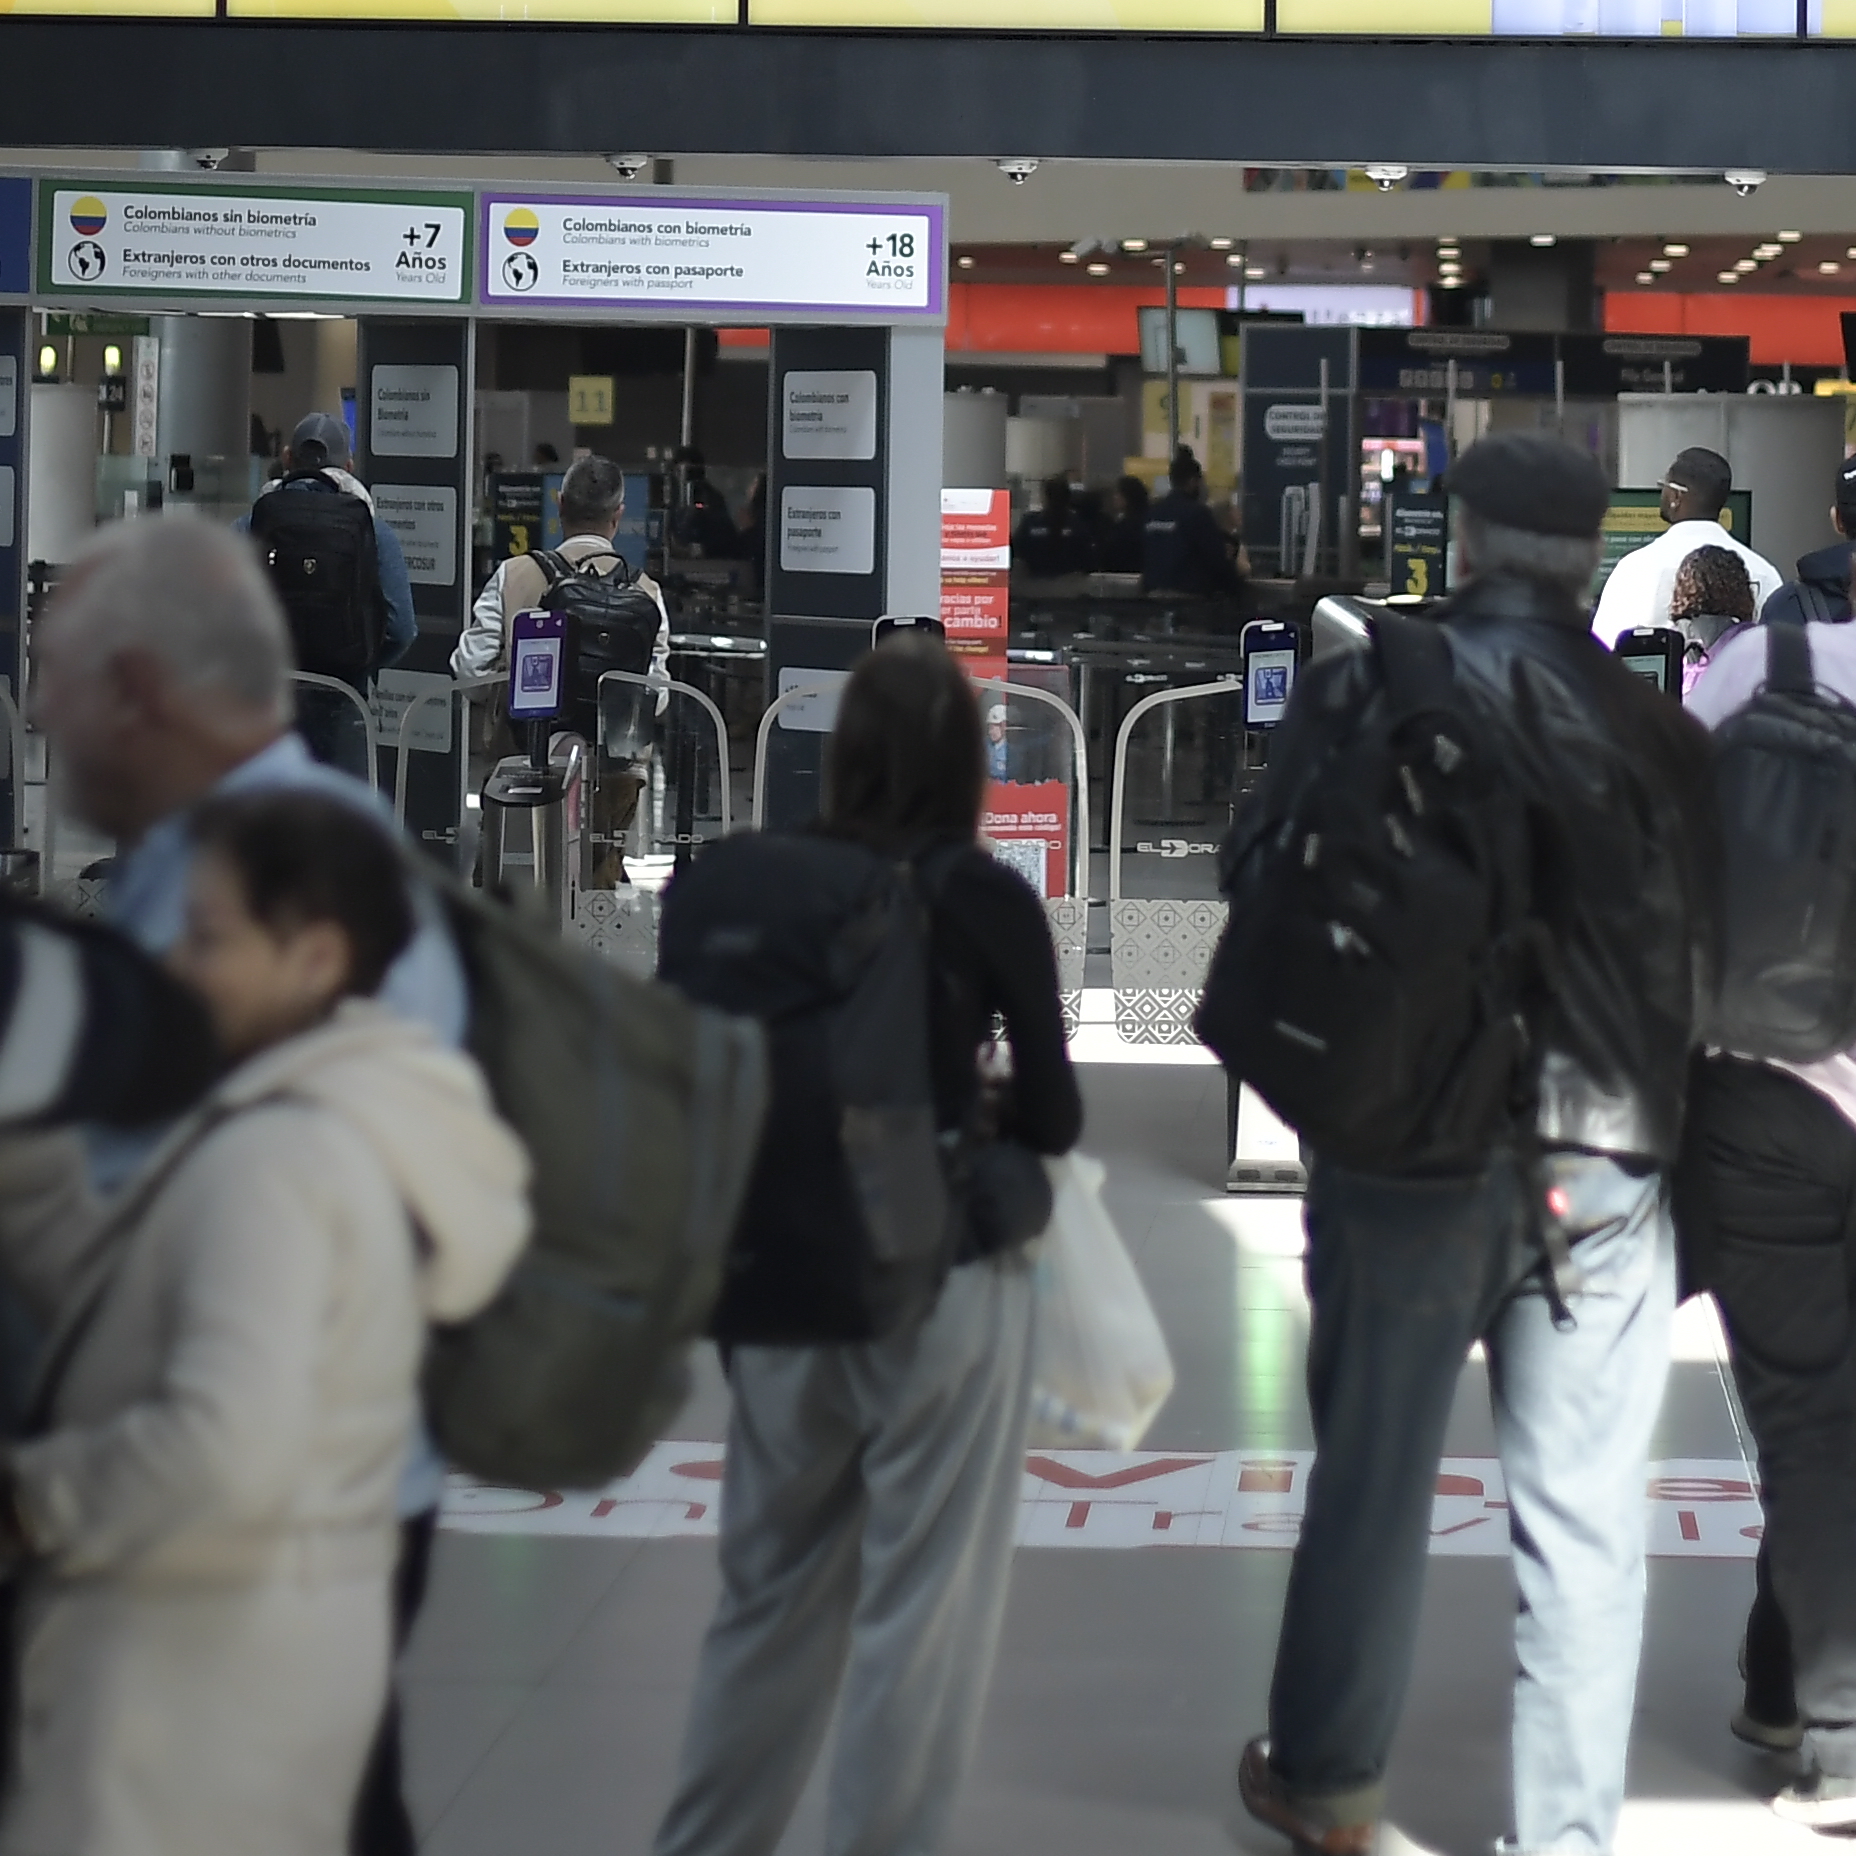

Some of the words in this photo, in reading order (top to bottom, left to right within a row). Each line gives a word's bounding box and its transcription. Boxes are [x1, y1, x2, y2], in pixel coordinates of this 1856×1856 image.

[123, 205, 218, 223] Colombianos
[223, 208, 243, 223] sin
[247, 209, 317, 227] biometría
[123, 221, 190, 235] Colombians
[194, 223, 234, 236] without
[238, 226, 297, 239] biometrics
[402, 223, 442, 249] +7
[562, 218, 653, 235] Colombianos
[657, 223, 682, 235] con
[685, 221, 752, 237] biometría
[562, 233, 626, 246] Colombians
[629, 235, 652, 246] with
[654, 235, 710, 248] biometrics
[866, 233, 915, 258] +18
[123, 249, 206, 269] Extranjeros
[211, 255, 235, 267] con
[240, 254, 278, 269] otros
[282, 255, 371, 272] documentos
[395, 250, 447, 271] Años
[562, 260, 641, 278] Extranjeros
[645, 265, 670, 276] con
[674, 264, 744, 280] pasaporte
[866, 260, 914, 278] Años
[122, 266, 181, 281] Foreigners
[185, 268, 209, 280] with
[212, 270, 241, 282] other
[245, 270, 307, 284] documents
[396, 272, 423, 283] Years
[426, 272, 446, 284] Old
[562, 276, 620, 290] Foreigners
[622, 276, 644, 288] with
[647, 278, 693, 291] passport
[866, 278, 892, 290] Years
[894, 279, 913, 290] Old
[575, 390, 607, 412] 11
[509, 525, 530, 556] 3
[1406, 558, 1428, 595] 3
[940, 593, 972, 605] racias
